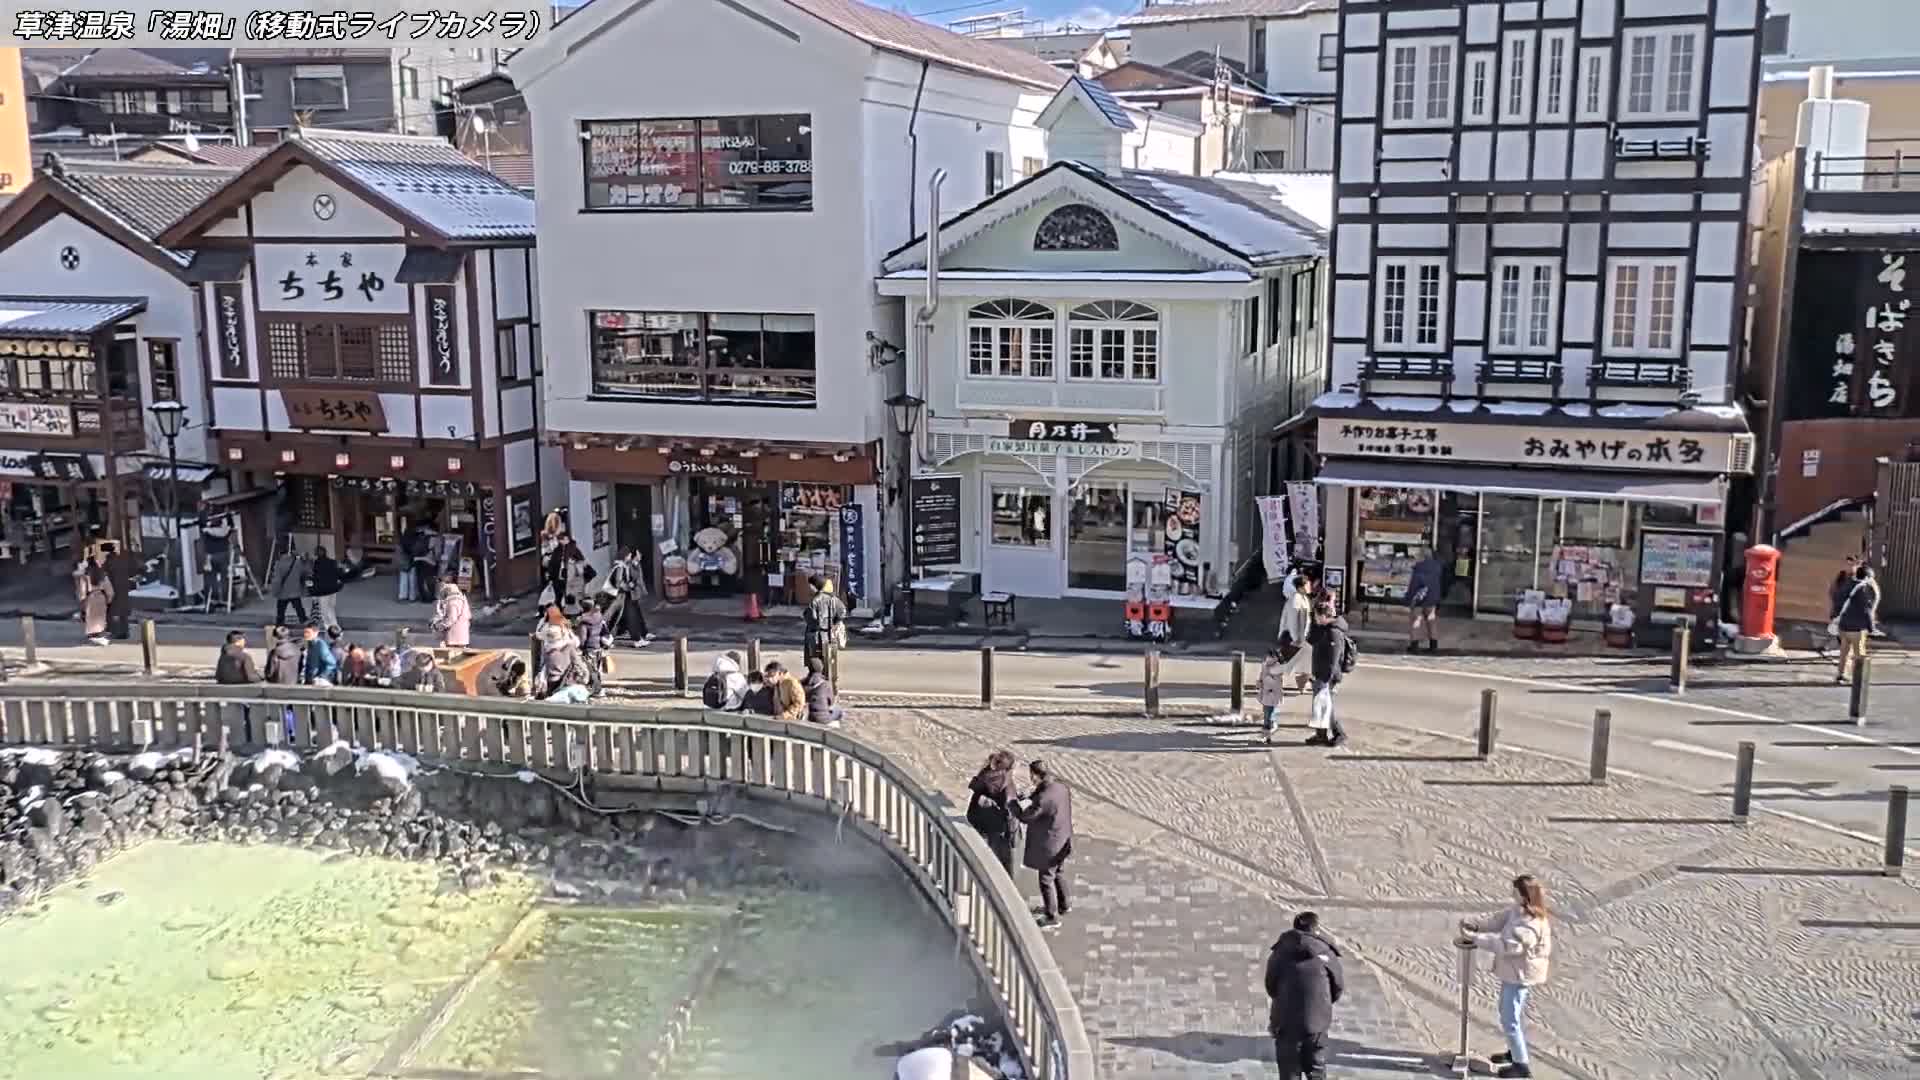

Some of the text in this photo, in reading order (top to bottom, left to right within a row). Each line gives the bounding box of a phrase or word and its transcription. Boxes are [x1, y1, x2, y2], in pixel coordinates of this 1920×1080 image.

[279, 270, 385, 302] ちちや
[1865, 253, 1912, 408] そばきち
[1028, 421, 1100, 441] 月乃井
[1524, 437, 1704, 464] おみやげの本多
